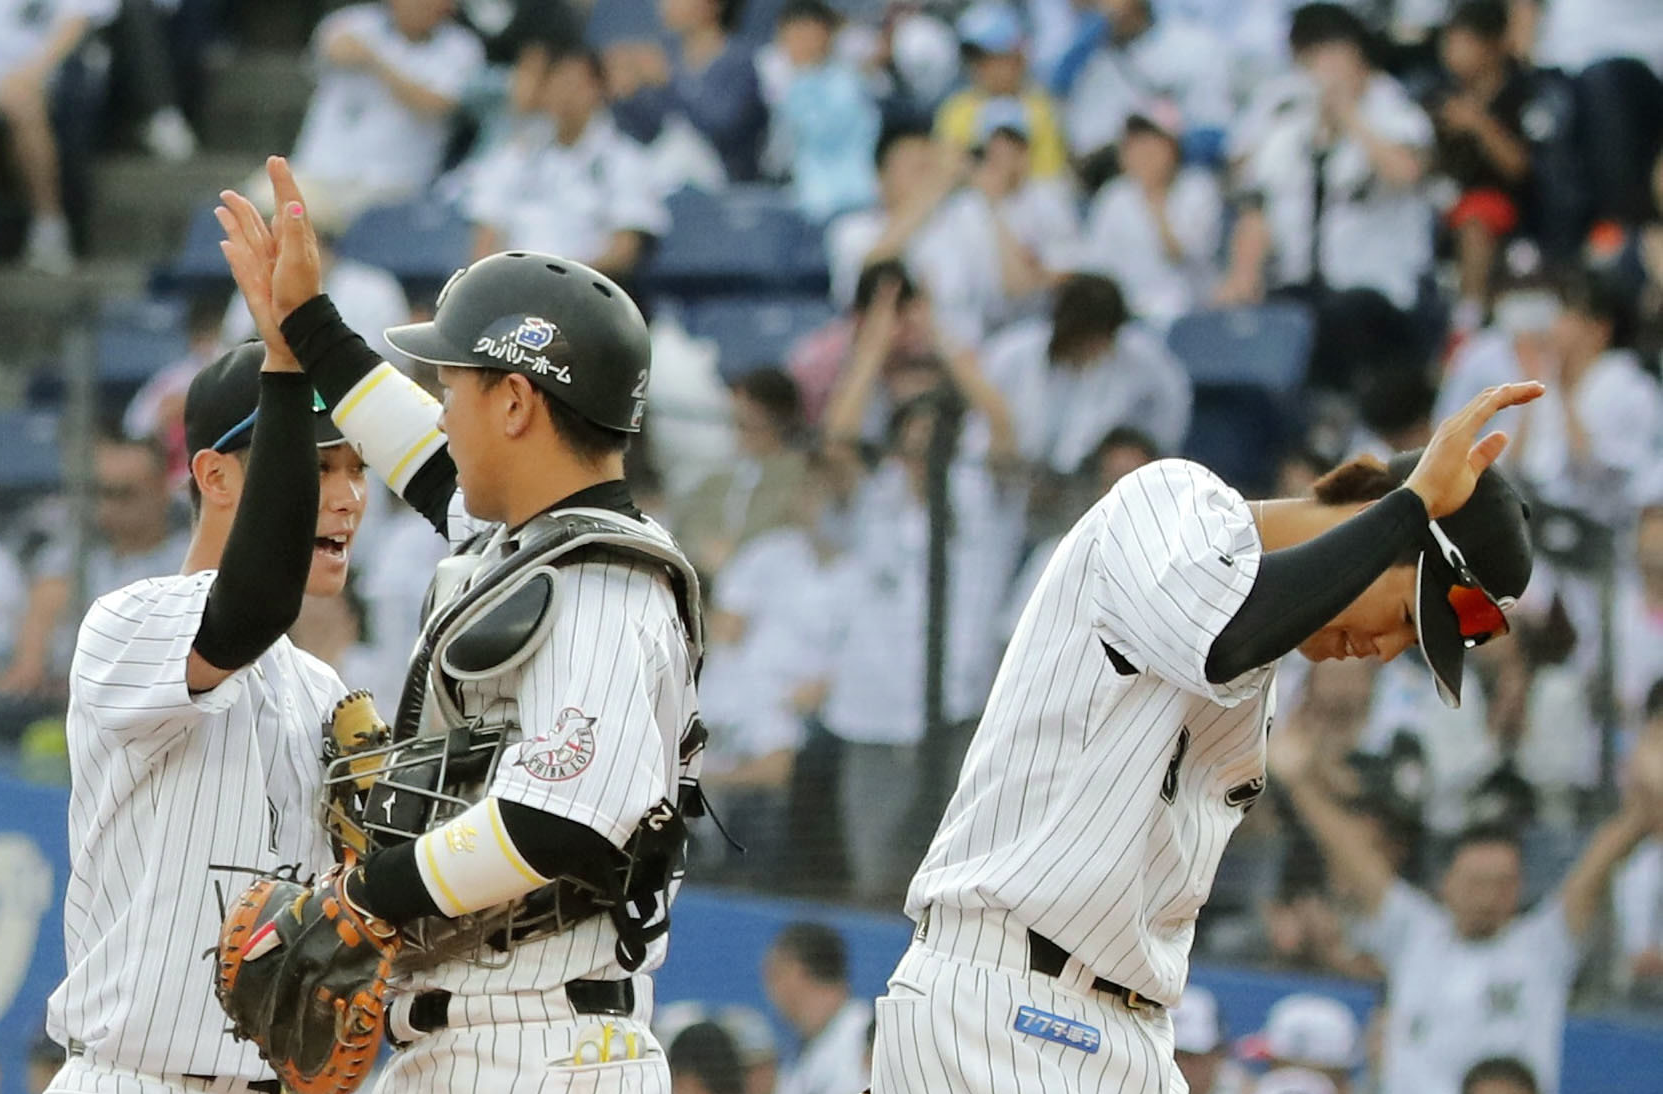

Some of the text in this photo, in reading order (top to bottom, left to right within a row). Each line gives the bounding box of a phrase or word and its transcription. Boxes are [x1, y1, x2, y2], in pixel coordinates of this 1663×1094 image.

[473, 331, 572, 385] クレバリーホーム
